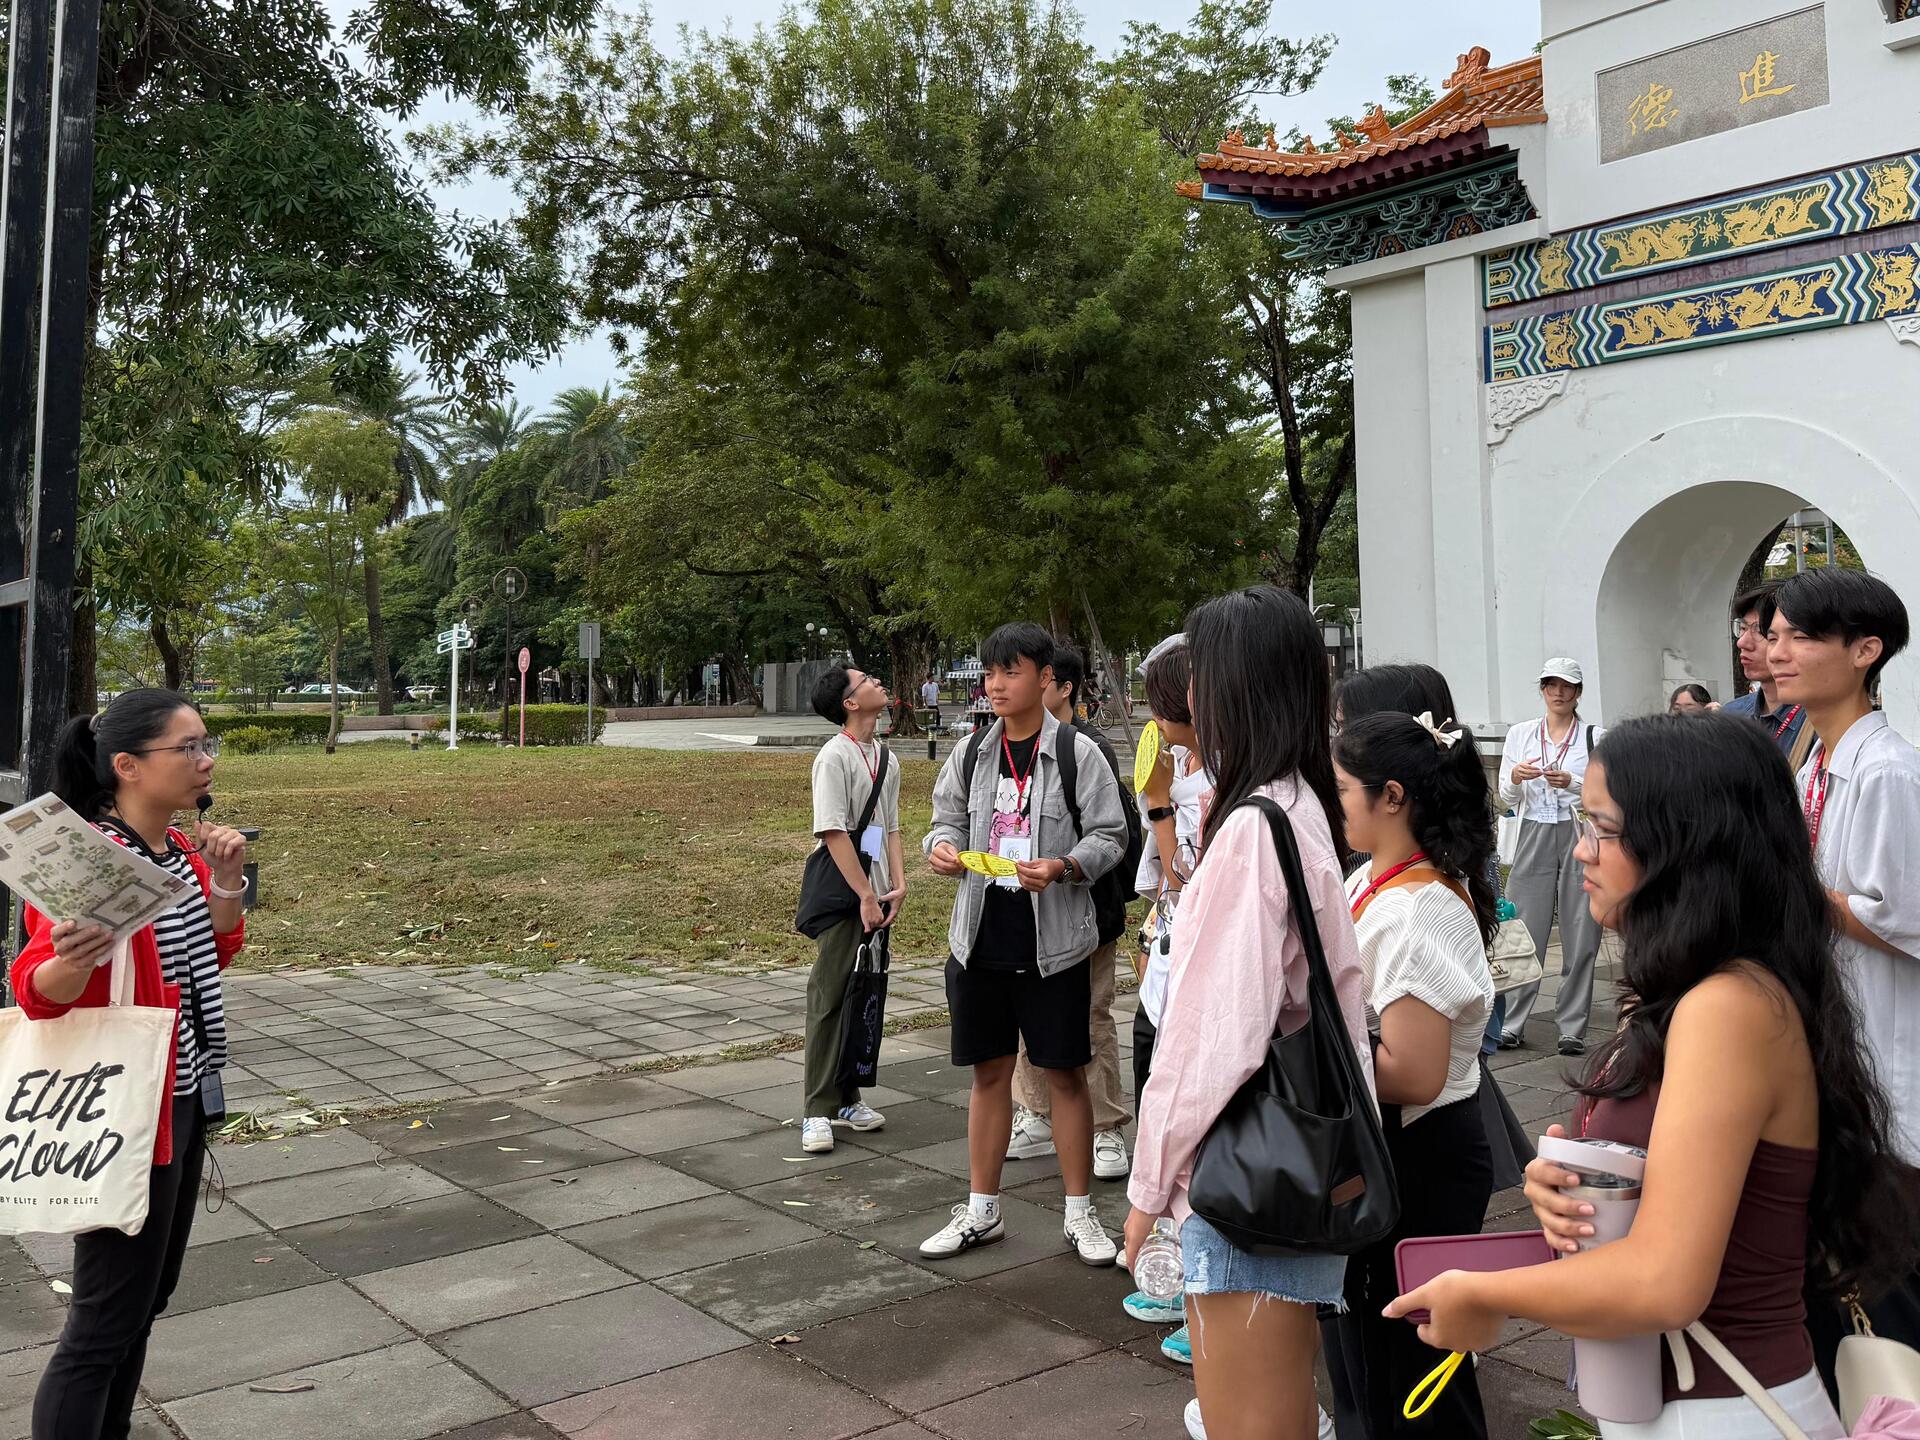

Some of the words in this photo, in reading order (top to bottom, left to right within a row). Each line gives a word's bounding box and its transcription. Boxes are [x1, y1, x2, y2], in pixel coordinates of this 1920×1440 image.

[5, 1062, 125, 1132] ELITE
[0, 1128, 124, 1183] CLOUD
[14, 1196, 38, 1206] ELITE
[49, 1197, 70, 1205] FOR
[73, 1197, 99, 1205] ELITE
